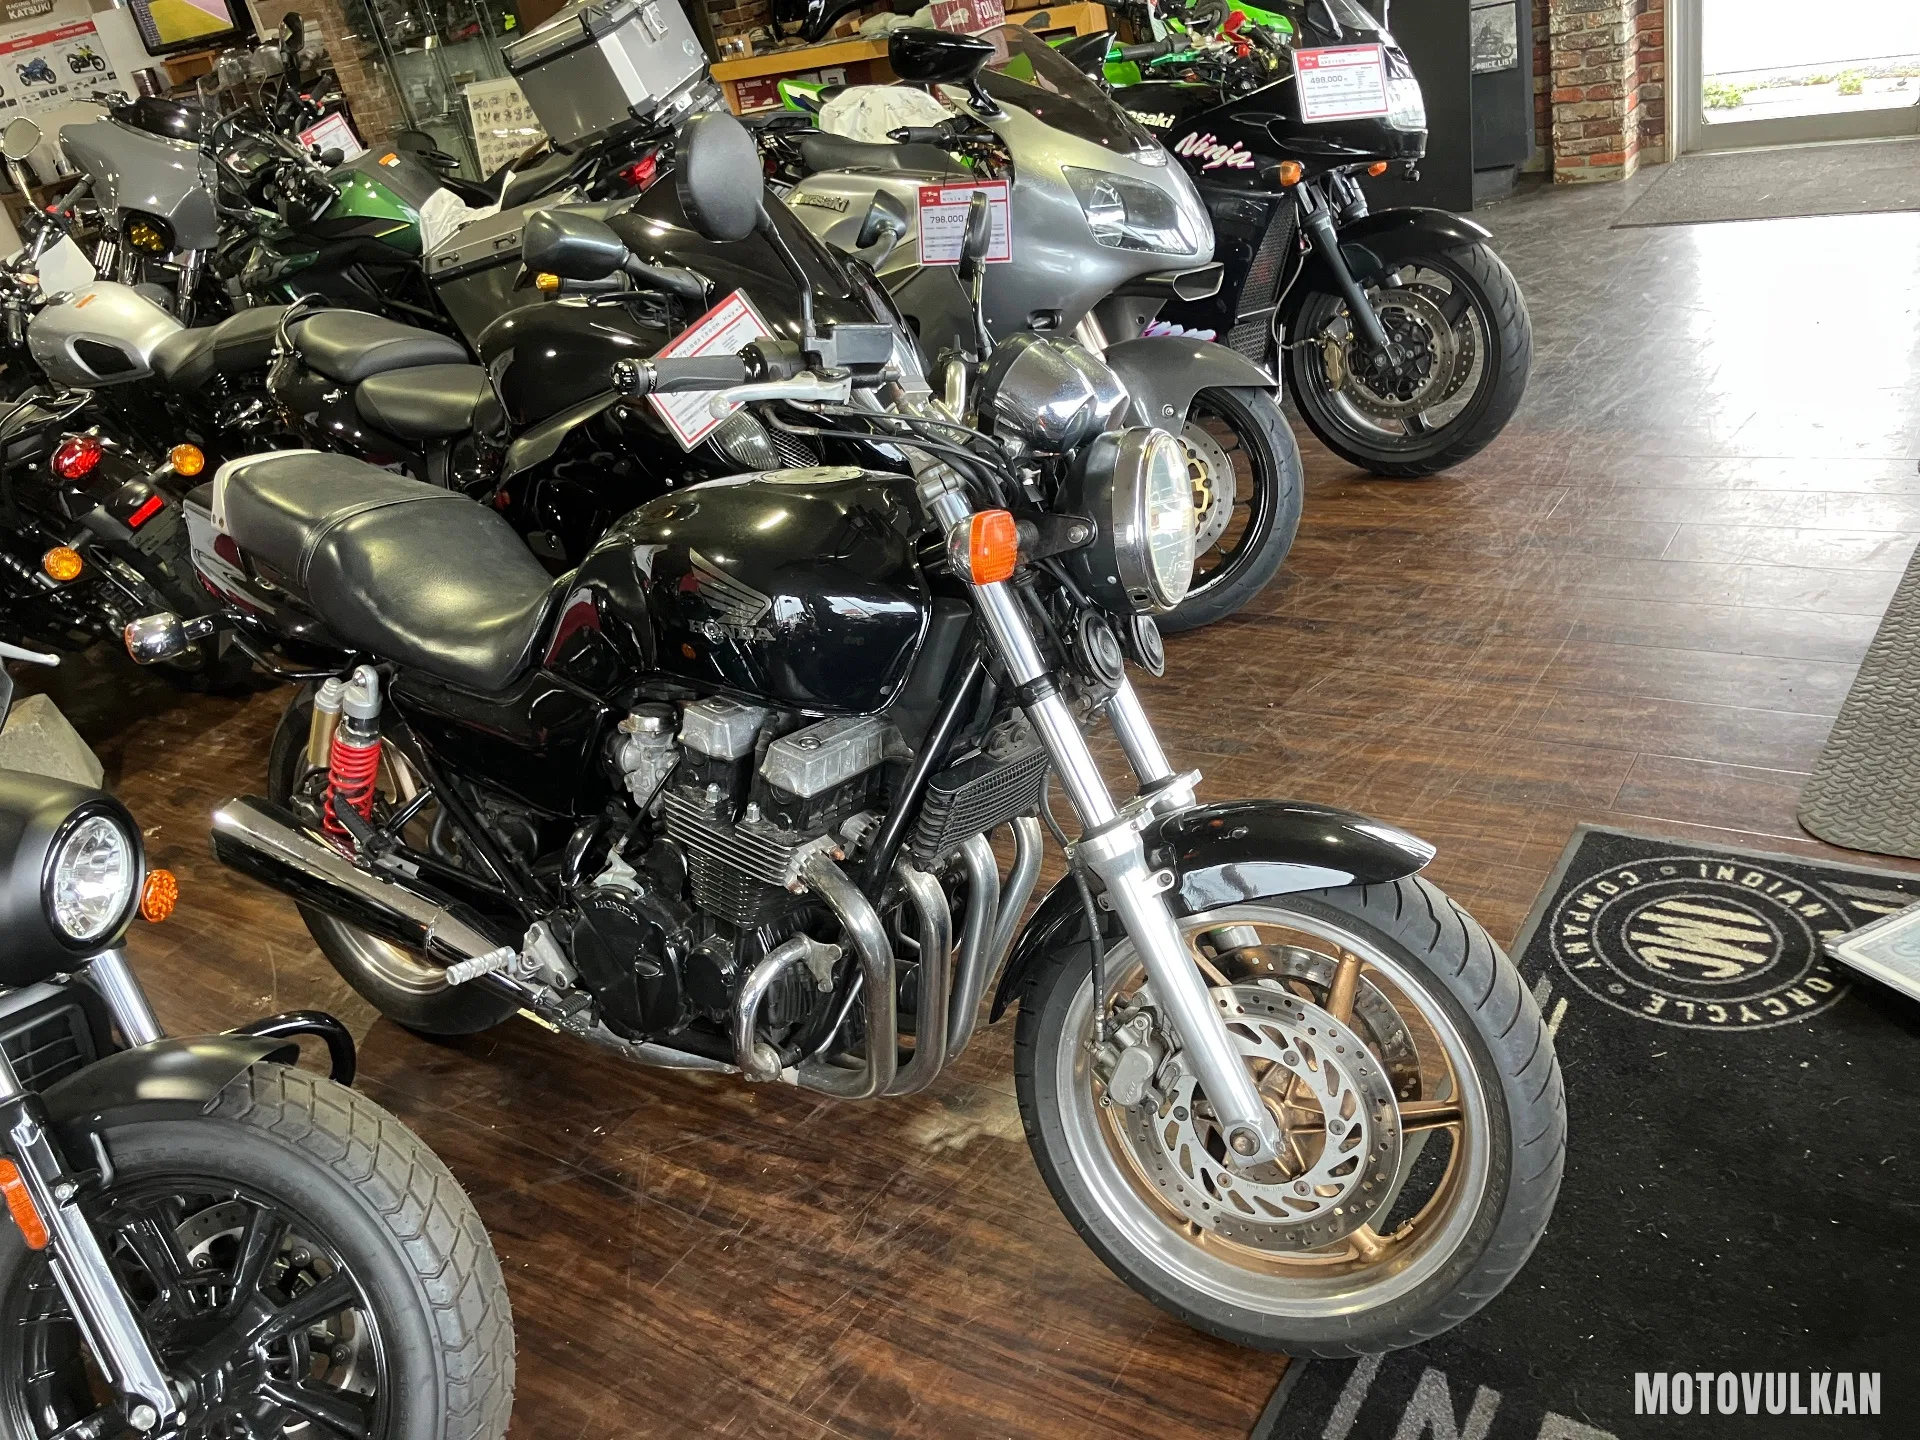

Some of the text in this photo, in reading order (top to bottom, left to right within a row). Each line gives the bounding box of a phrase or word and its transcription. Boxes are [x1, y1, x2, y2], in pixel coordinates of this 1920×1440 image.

[8, 2, 51, 20] KATSUKI
[1476, 58, 1513, 70] PRICE LIST
[1174, 131, 1255, 170] Ninja
[687, 618, 777, 642] HONDA
[1699, 862, 1828, 919] INDIAN
[1562, 870, 1640, 970] COMPANY
